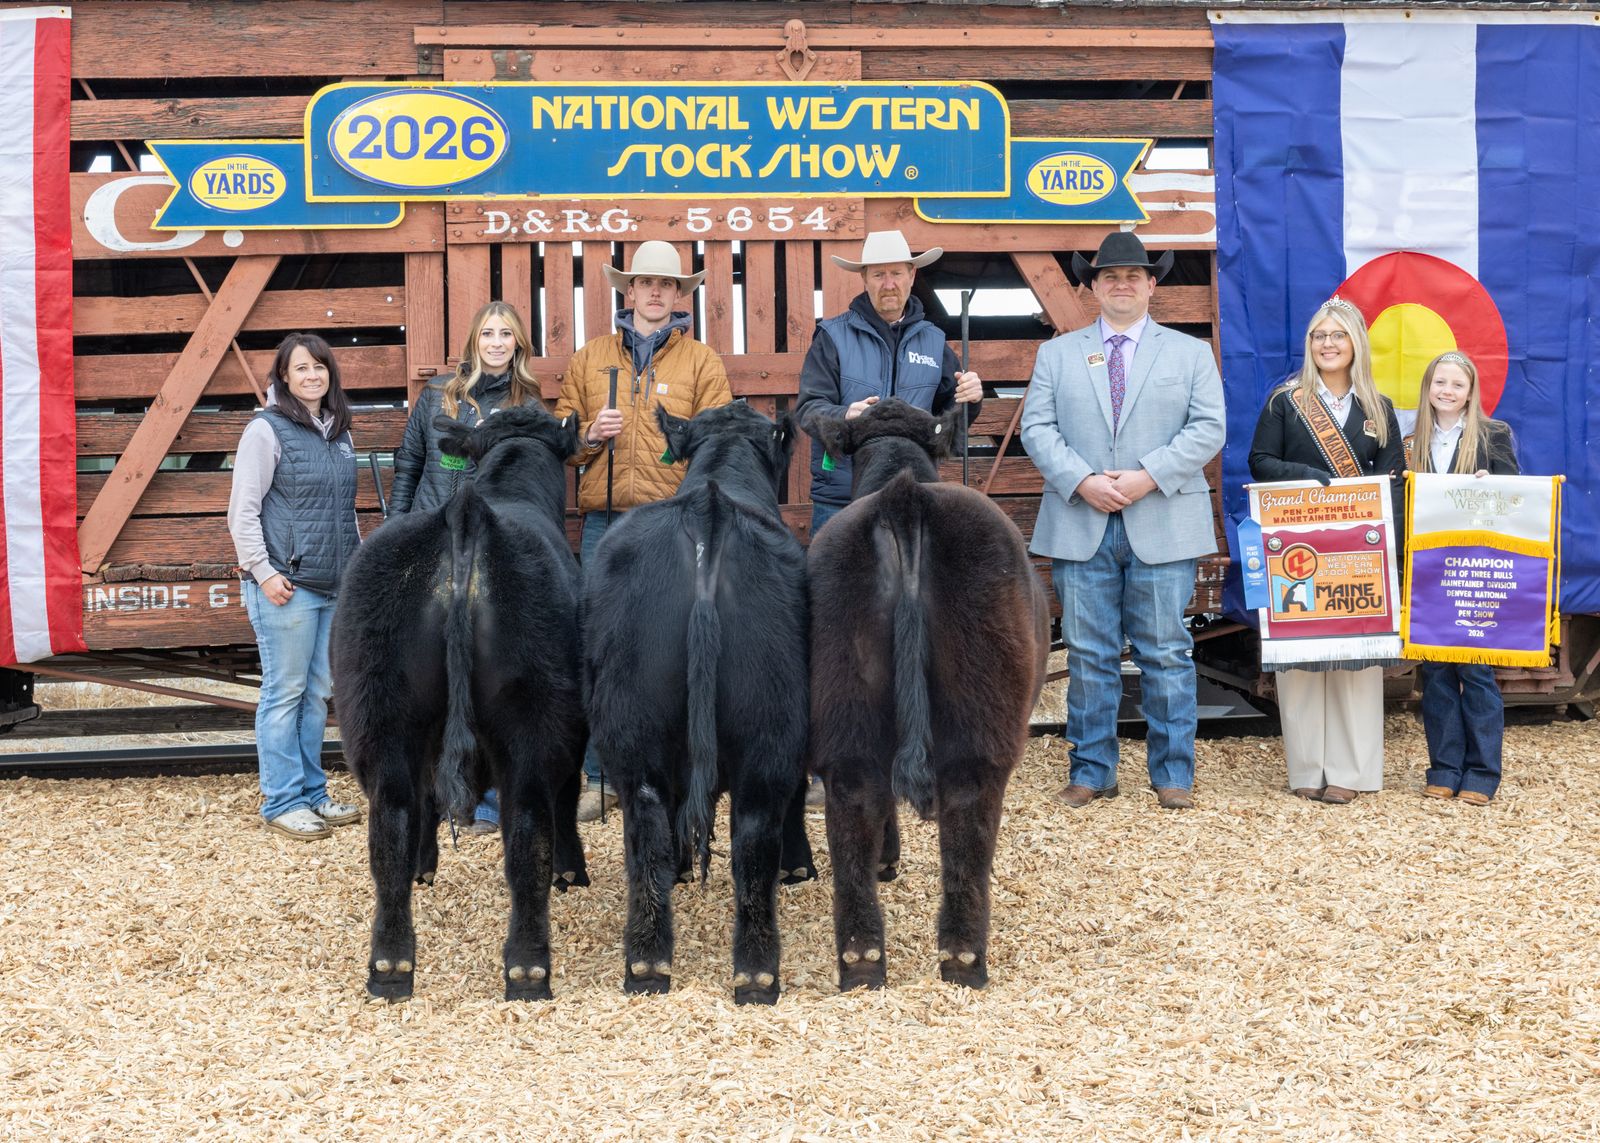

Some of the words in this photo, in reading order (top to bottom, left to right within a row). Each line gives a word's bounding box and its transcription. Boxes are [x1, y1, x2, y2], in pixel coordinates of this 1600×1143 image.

[532, 95, 749, 131] NATIONAL
[766, 96, 980, 130] WESTERN
[347, 115, 495, 160] 2026
[607, 143, 752, 178] STOCK
[759, 143, 901, 178] SHOW
[227, 163, 235, 171] IN
[236, 163, 249, 171] THE
[203, 172, 275, 195] YARDS
[1040, 169, 1105, 190] YARDS
[1261, 490, 1304, 512] Grand
[1308, 488, 1379, 507] Champion
[1444, 488, 1505, 500] NATIONAL
[1273, 513, 1338, 524] MAINETAINER
[1342, 511, 1373, 519] BULLS
[1328, 561, 1373, 569] WESTERN
[1444, 557, 1514, 569] CHAMPION
[1317, 569, 1349, 577] STOCK
[1444, 569, 1456, 577] PEN
[1459, 570, 1468, 578] OF
[1471, 570, 1491, 579] THREE
[1493, 571, 1513, 579] BULLS
[1315, 582, 1375, 598] MAINE
[1440, 579, 1484, 588] MAINETAINER
[1487, 581, 1517, 589] DIVISION
[87, 585, 191, 612] INSIDE
[208, 583, 229, 608] 6
[1446, 590, 1472, 598] DENVER
[1474, 591, 1507, 599] NATIONAL
[1325, 595, 1382, 613] ANJOU
[1454, 600, 1500, 609] MAINE-ANJOU
[1458, 609, 1471, 617] PEN
[1474, 610, 1495, 618] SHOW
[1468, 629, 1484, 637] 2026
